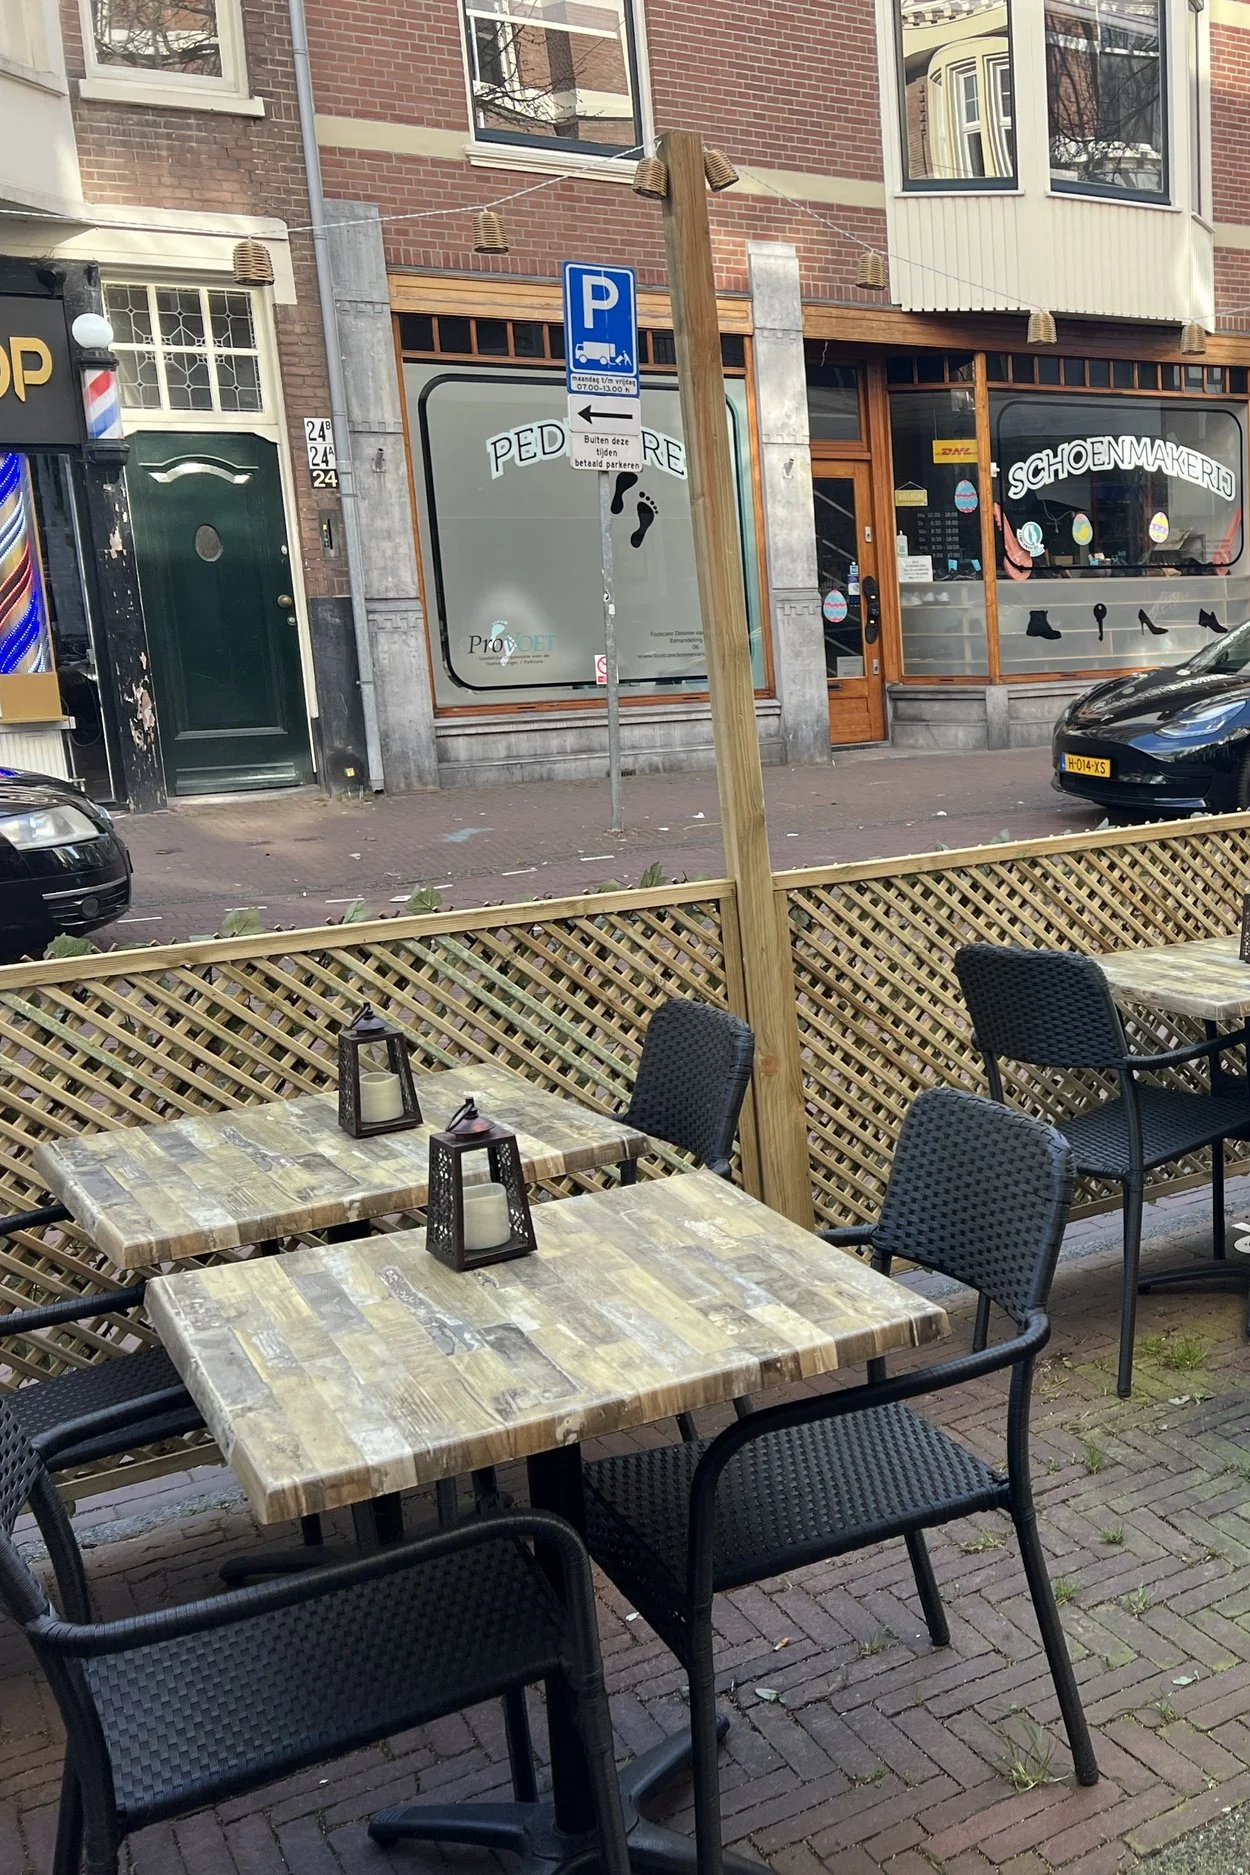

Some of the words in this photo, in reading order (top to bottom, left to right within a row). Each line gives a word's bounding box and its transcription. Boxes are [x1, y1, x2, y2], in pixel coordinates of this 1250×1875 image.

[582, 274, 619, 329] P
[0, 336, 53, 402] P
[572, 376, 600, 384] maandag
[616, 378, 636, 387] vrijdag
[584, 435, 610, 444] Buiten
[612, 437, 629, 445] deze
[486, 418, 688, 480] PEDRE
[596, 448, 618, 458] tijden
[941, 447, 973, 456] DHL
[575, 459, 603, 468] betaald
[606, 461, 640, 469] parkeren
[1008, 436, 1235, 501] SCHOENMAKERIJ
[312, 470, 338, 487] 24
[1068, 757, 1106, 774] H-014-XS
